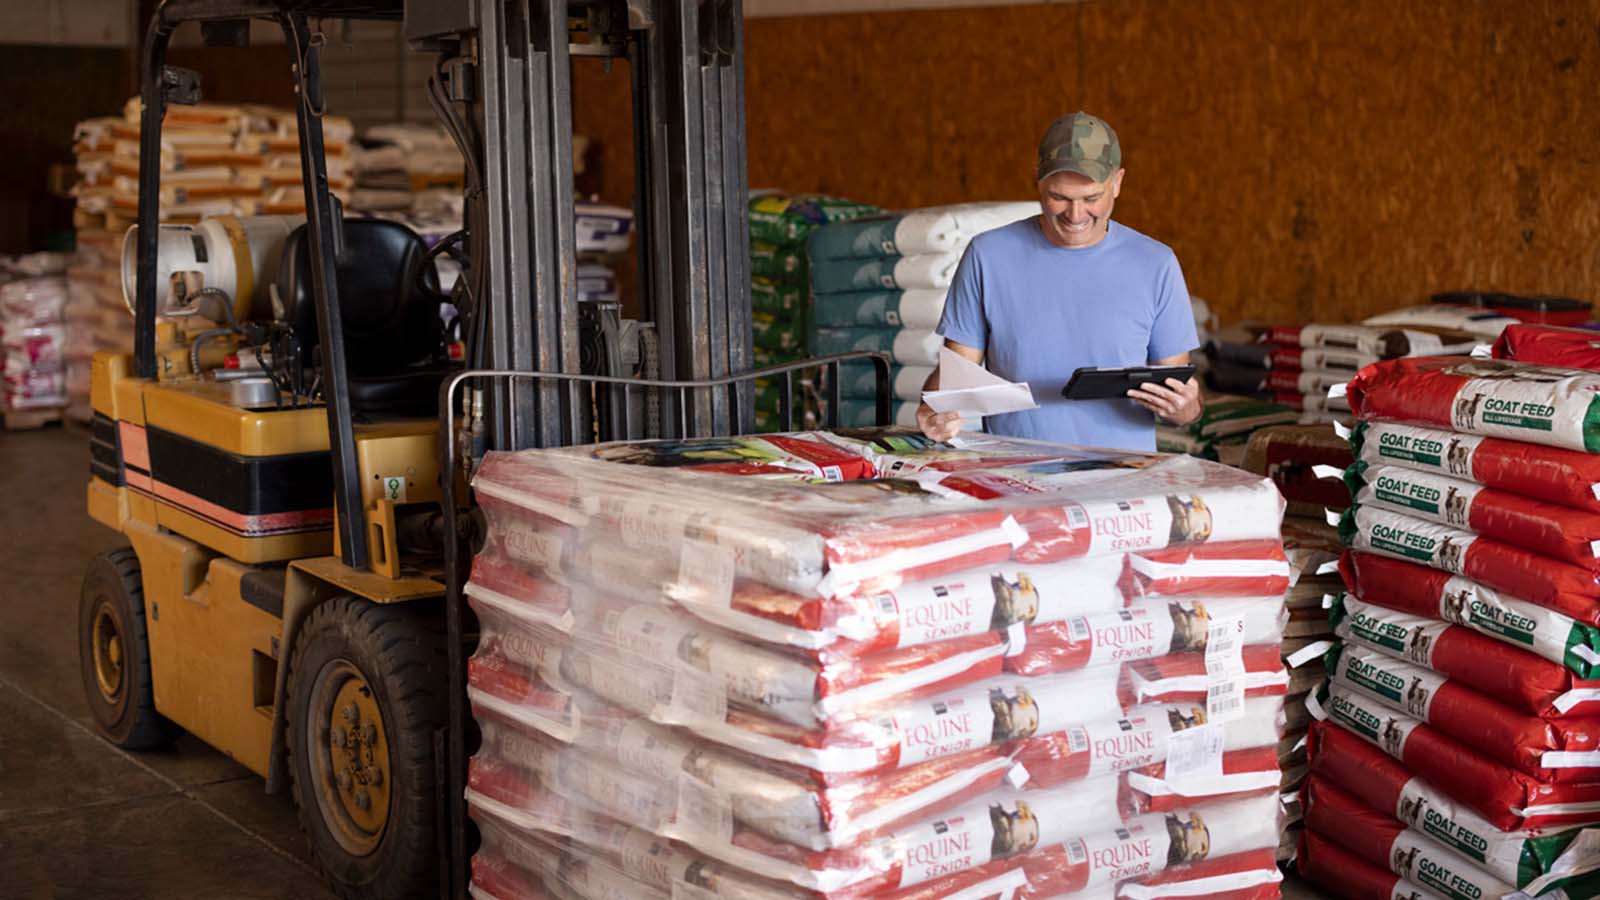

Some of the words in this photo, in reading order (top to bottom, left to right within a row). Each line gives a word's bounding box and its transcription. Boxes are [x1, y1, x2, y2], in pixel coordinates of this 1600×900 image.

[1484, 398, 1520, 414] GOAT
[1520, 403, 1555, 418] FEED
[1380, 432, 1412, 448] GOAT
[1412, 438, 1443, 454] FEED
[1377, 476, 1409, 493] GOAT
[1409, 484, 1440, 501] FEED
[1095, 512, 1152, 537] EQUINE
[1372, 524, 1405, 541] GOAT
[1404, 533, 1436, 549] FEED
[1110, 535, 1152, 551] SENIOR
[905, 598, 972, 627] EQUINE
[1471, 600, 1502, 620] GOAT
[1503, 612, 1537, 632] FEED
[923, 622, 971, 640] SENIOR
[1096, 622, 1153, 648] EQUINE
[1237, 619, 1243, 632] S
[1378, 623, 1408, 639] FEED
[1111, 645, 1153, 661] SENIOR
[1348, 656, 1377, 677] GOAT
[1375, 670, 1405, 690] FEED
[904, 714, 971, 747] EQUINE
[1353, 708, 1380, 730] FEED
[923, 739, 971, 758] SENIOR
[1095, 731, 1153, 759] EQUINE
[1110, 754, 1152, 770] SENIOR
[1425, 808, 1456, 833] GOAT
[1456, 826, 1488, 851] FEED
[906, 832, 971, 868] EQUINE
[1093, 839, 1151, 869] EQUINE
[924, 856, 971, 879] SENIOR
[1108, 862, 1150, 881] SENIOR
[1419, 858, 1451, 881] GOAT
[1450, 875, 1482, 899] FEED
